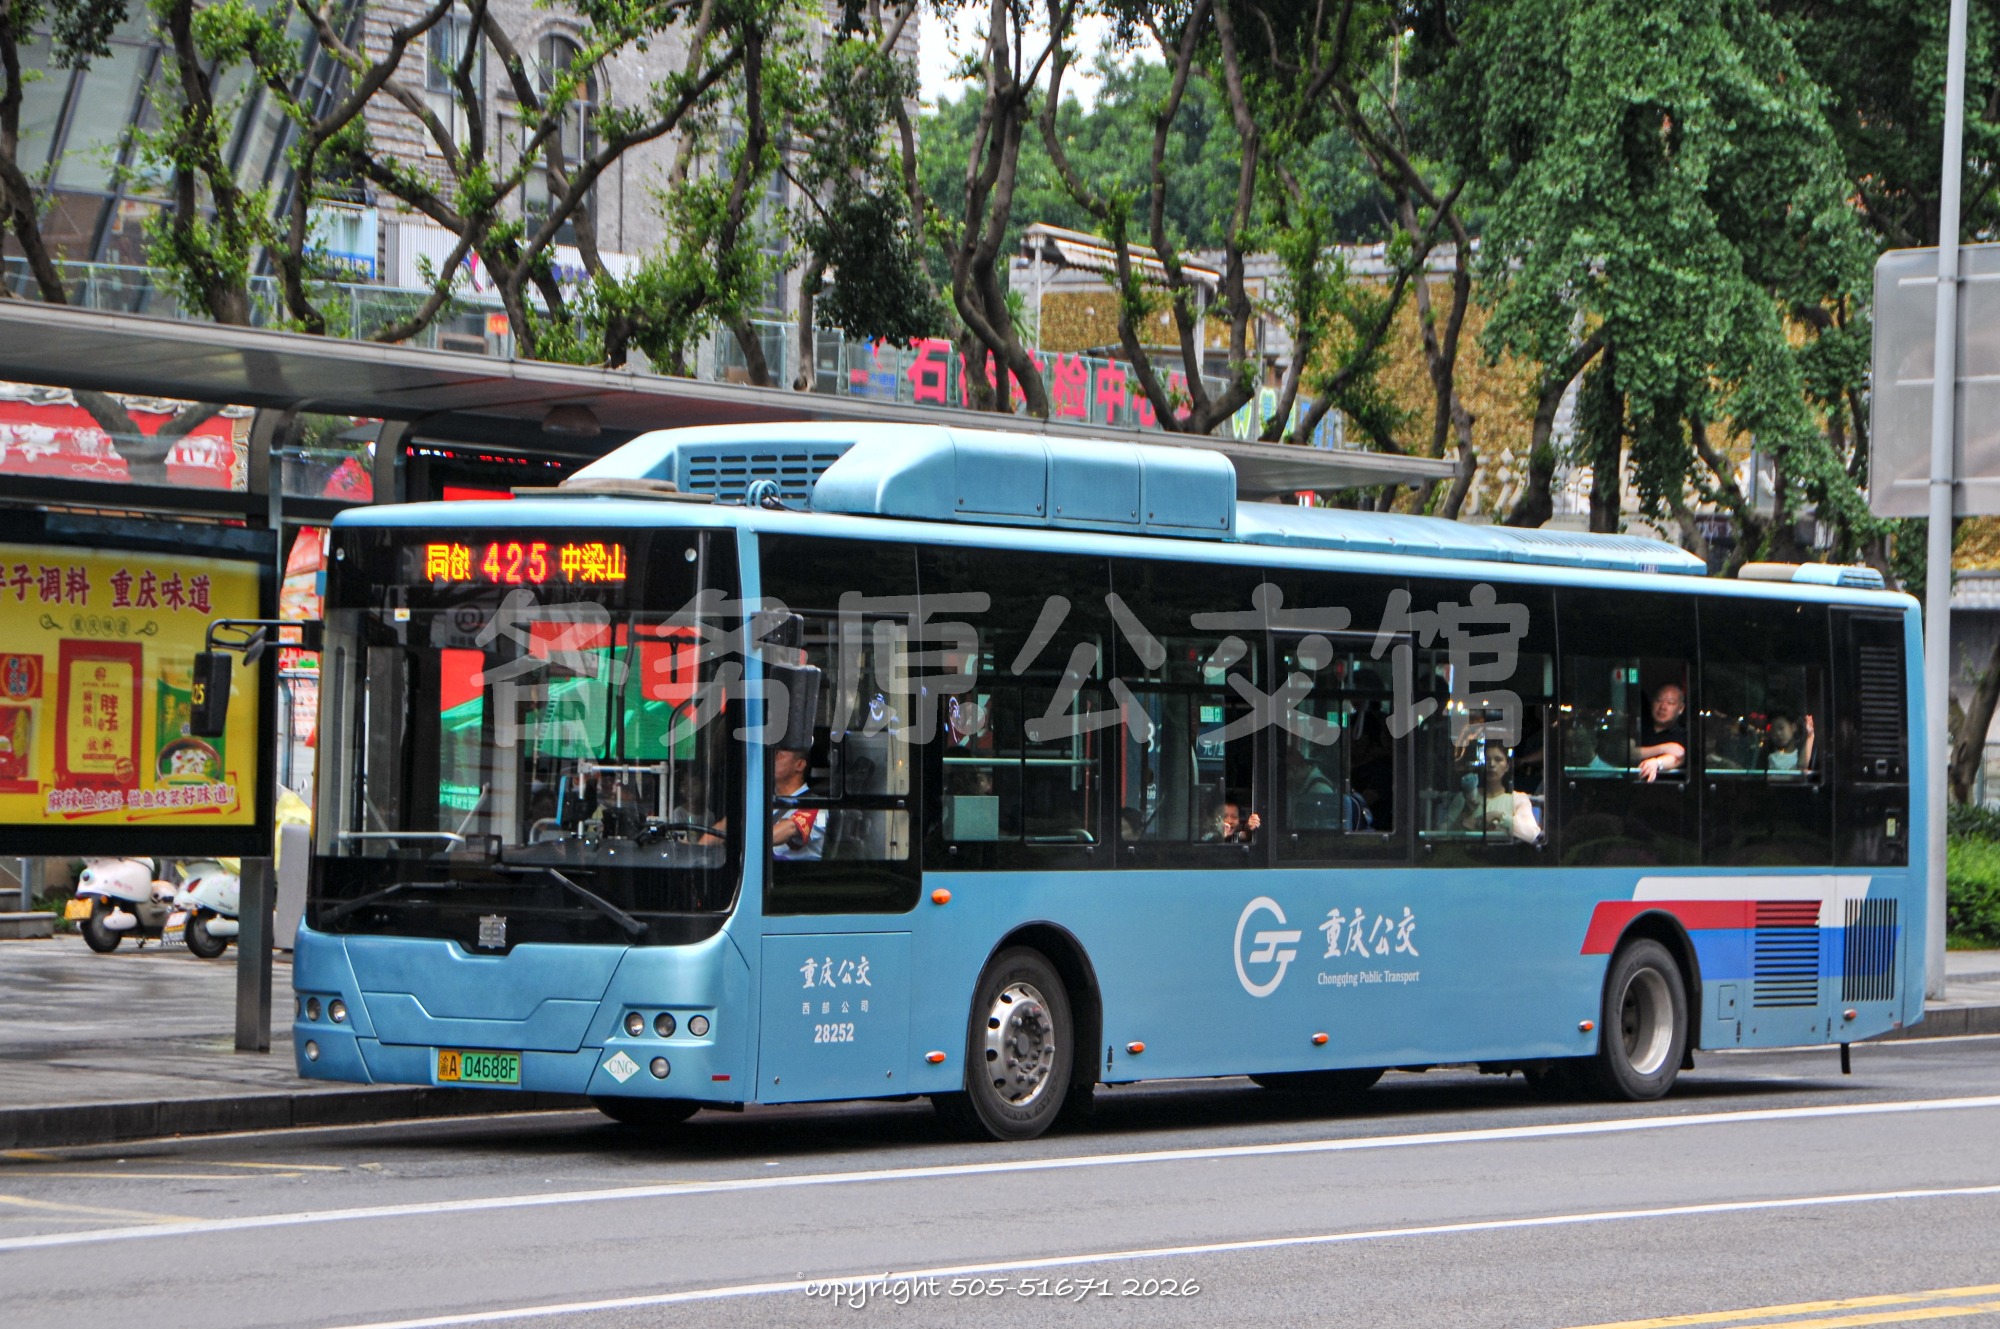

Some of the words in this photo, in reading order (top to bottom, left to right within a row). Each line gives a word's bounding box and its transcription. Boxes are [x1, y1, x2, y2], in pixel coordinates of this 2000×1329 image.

[427, 543, 471, 581] 同创
[482, 543, 547, 582] 425
[561, 543, 626, 582] 中梁山
[110, 569, 212, 615] 重庆味道
[1318, 906, 1420, 958] 重庆公交
[800, 956, 872, 989] 重庆公交
[1318, 972, 1358, 987] Chongqing
[1360, 971, 1382, 983] Public
[1384, 970, 1420, 985] Transport
[814, 1023, 855, 1043] 28252
[608, 1060, 634, 1074] CNG
